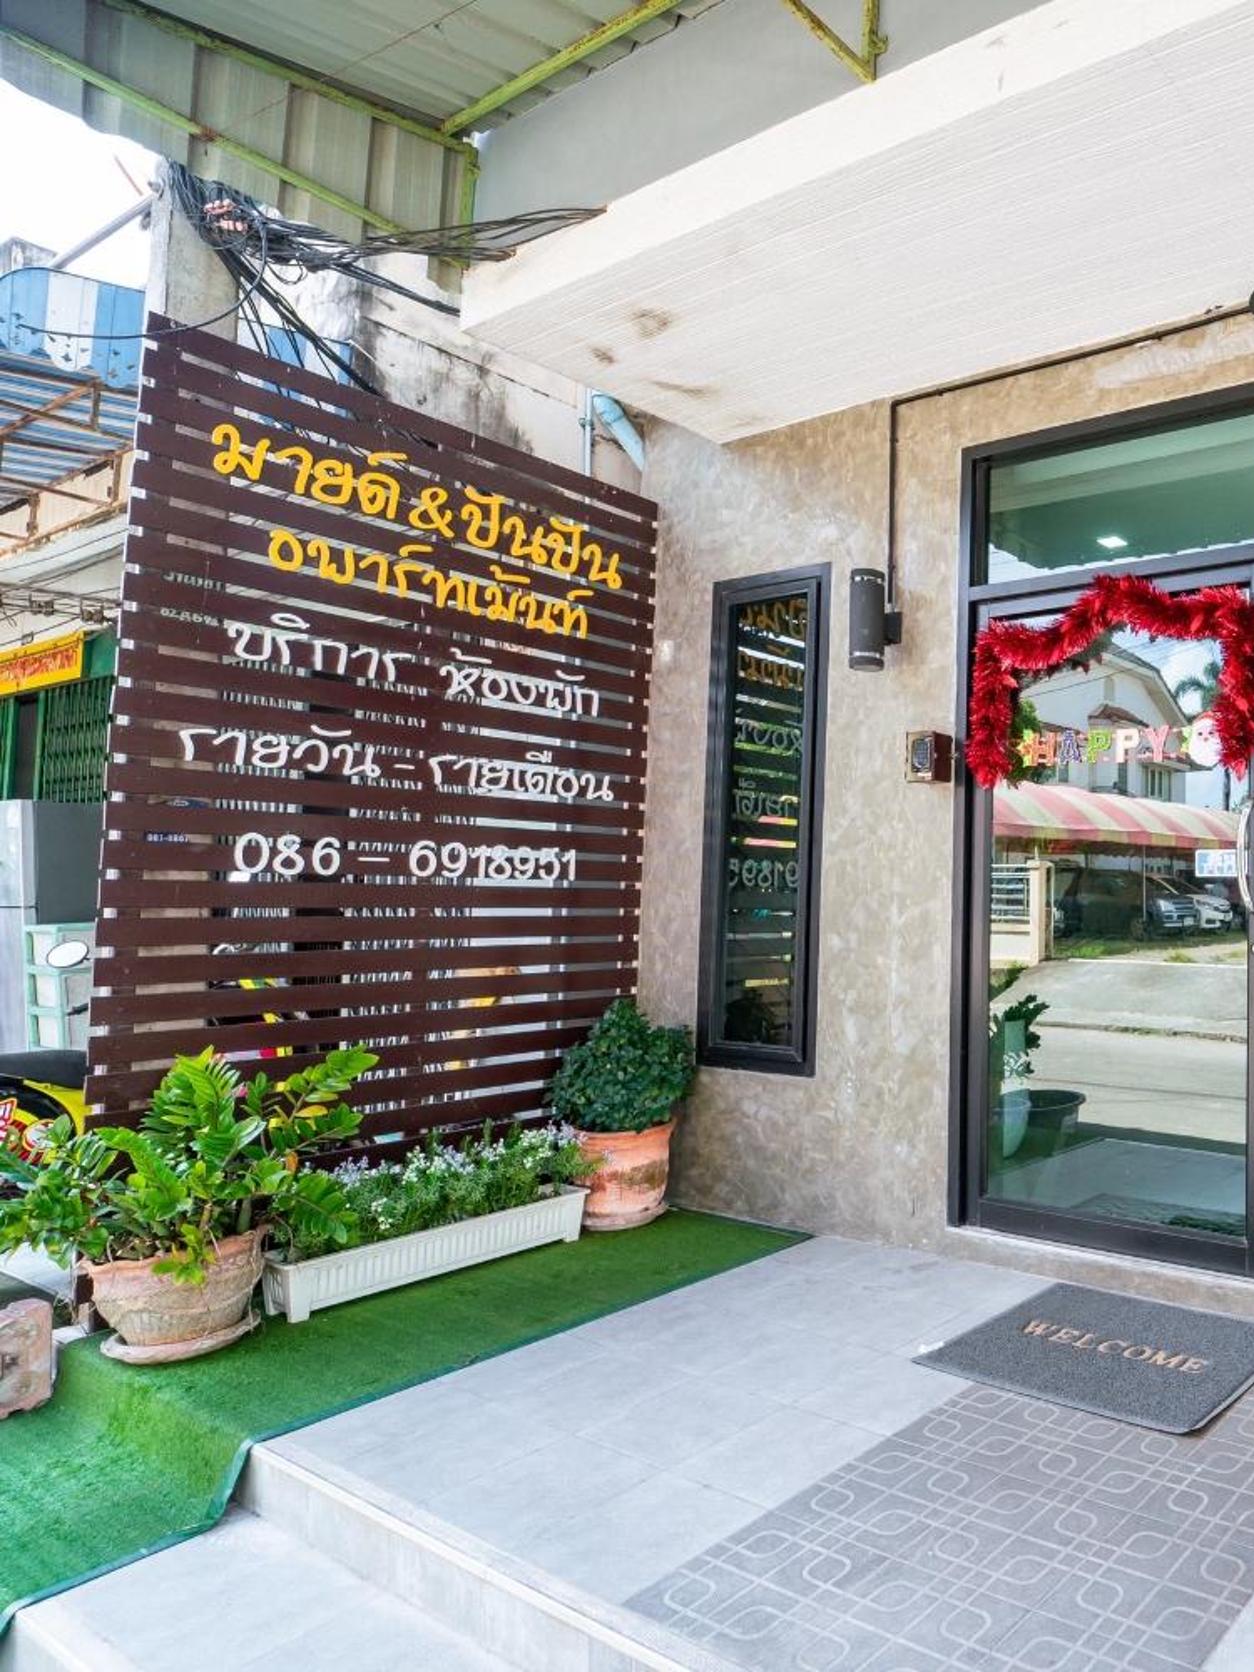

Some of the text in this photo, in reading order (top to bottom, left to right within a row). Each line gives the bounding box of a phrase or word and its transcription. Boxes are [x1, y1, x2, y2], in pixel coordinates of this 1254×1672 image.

[211, 423, 623, 589] มายด์ & ปันปัน
[268, 528, 595, 639] อพาร์ทเม้นท์
[227, 612, 600, 718] บริการ ห้องพัก
[178, 724, 382, 777] รายวัน
[428, 750, 614, 802] รายเดือน
[1031, 725, 1171, 767] HAPPY
[1022, 1318, 1208, 1374] WELCOME
